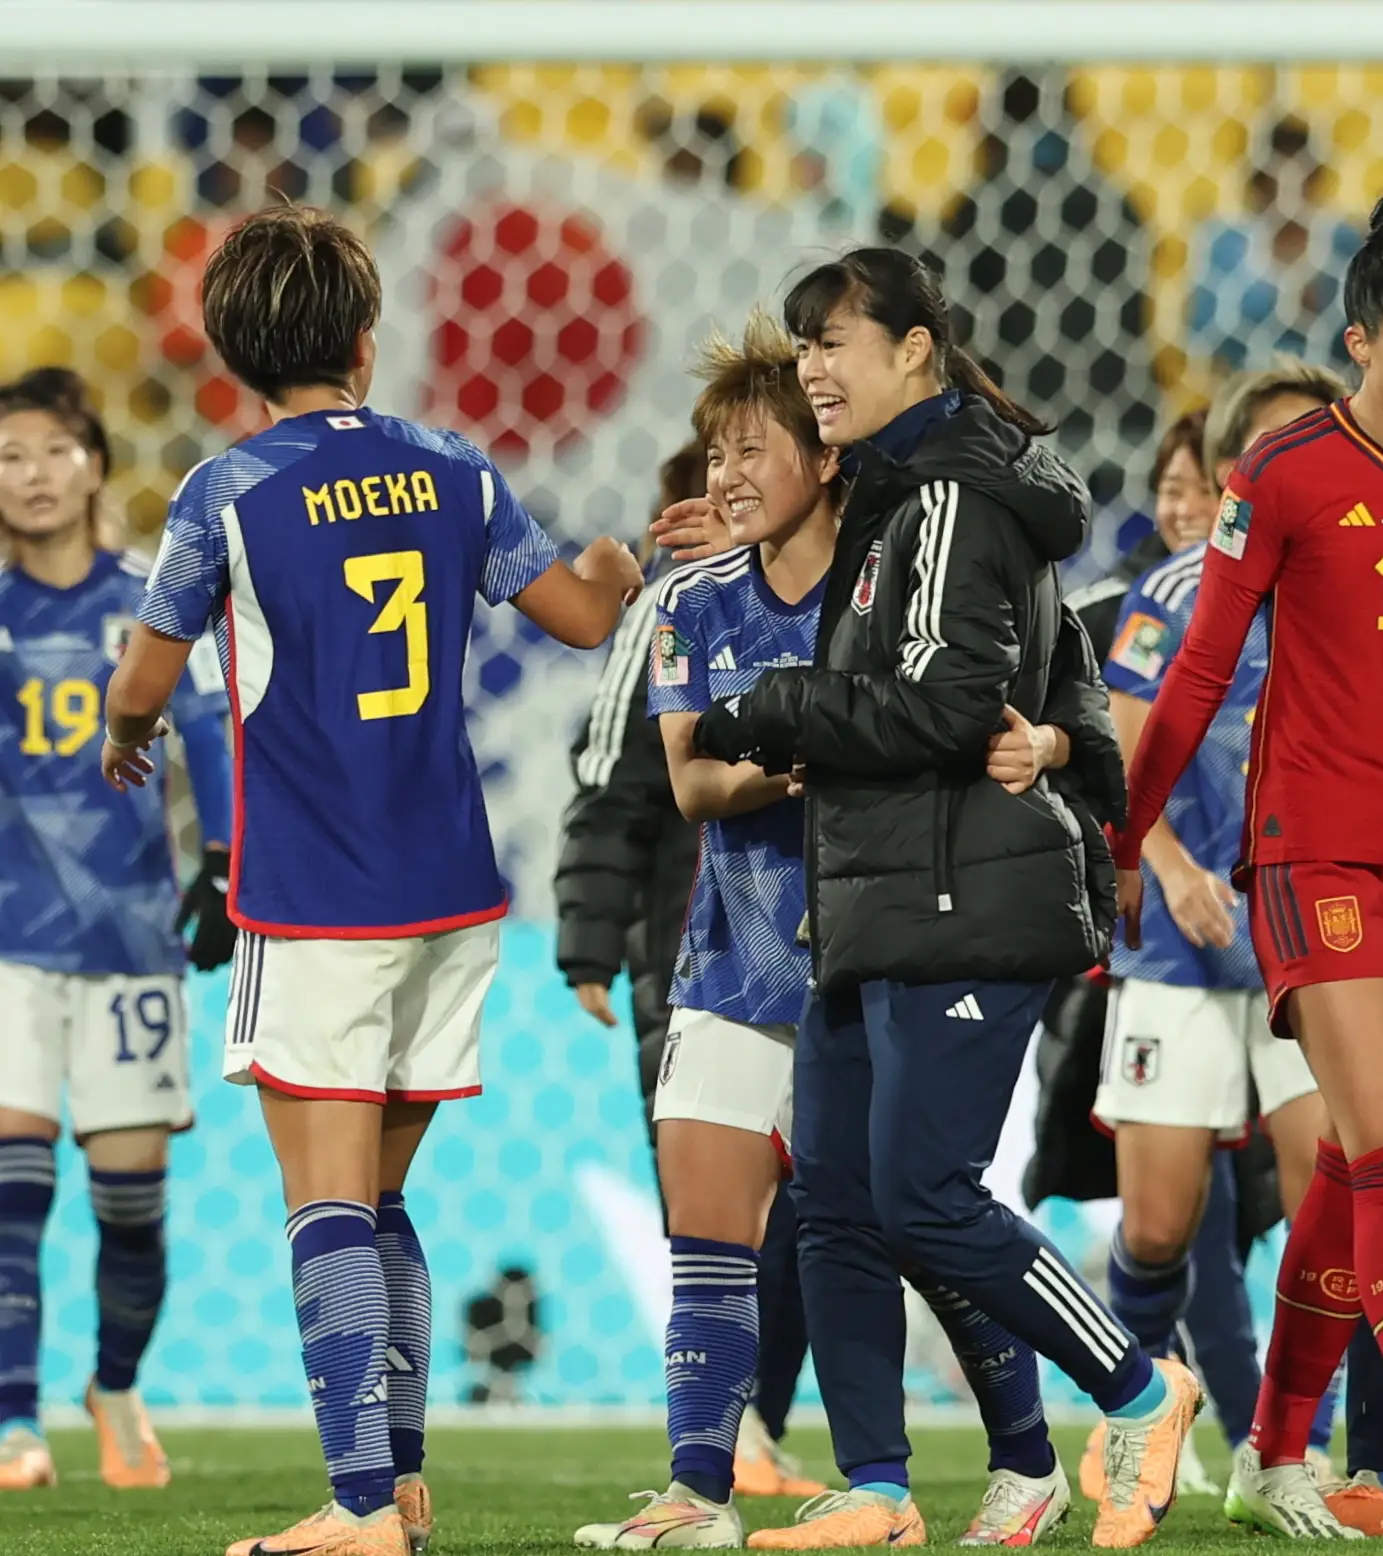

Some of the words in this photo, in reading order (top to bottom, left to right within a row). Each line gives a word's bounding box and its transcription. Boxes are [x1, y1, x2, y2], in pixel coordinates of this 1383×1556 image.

[302, 470, 439, 526] MOEKA
[343, 549, 431, 721] 3
[16, 677, 100, 756] 19
[110, 990, 171, 1062] 19
